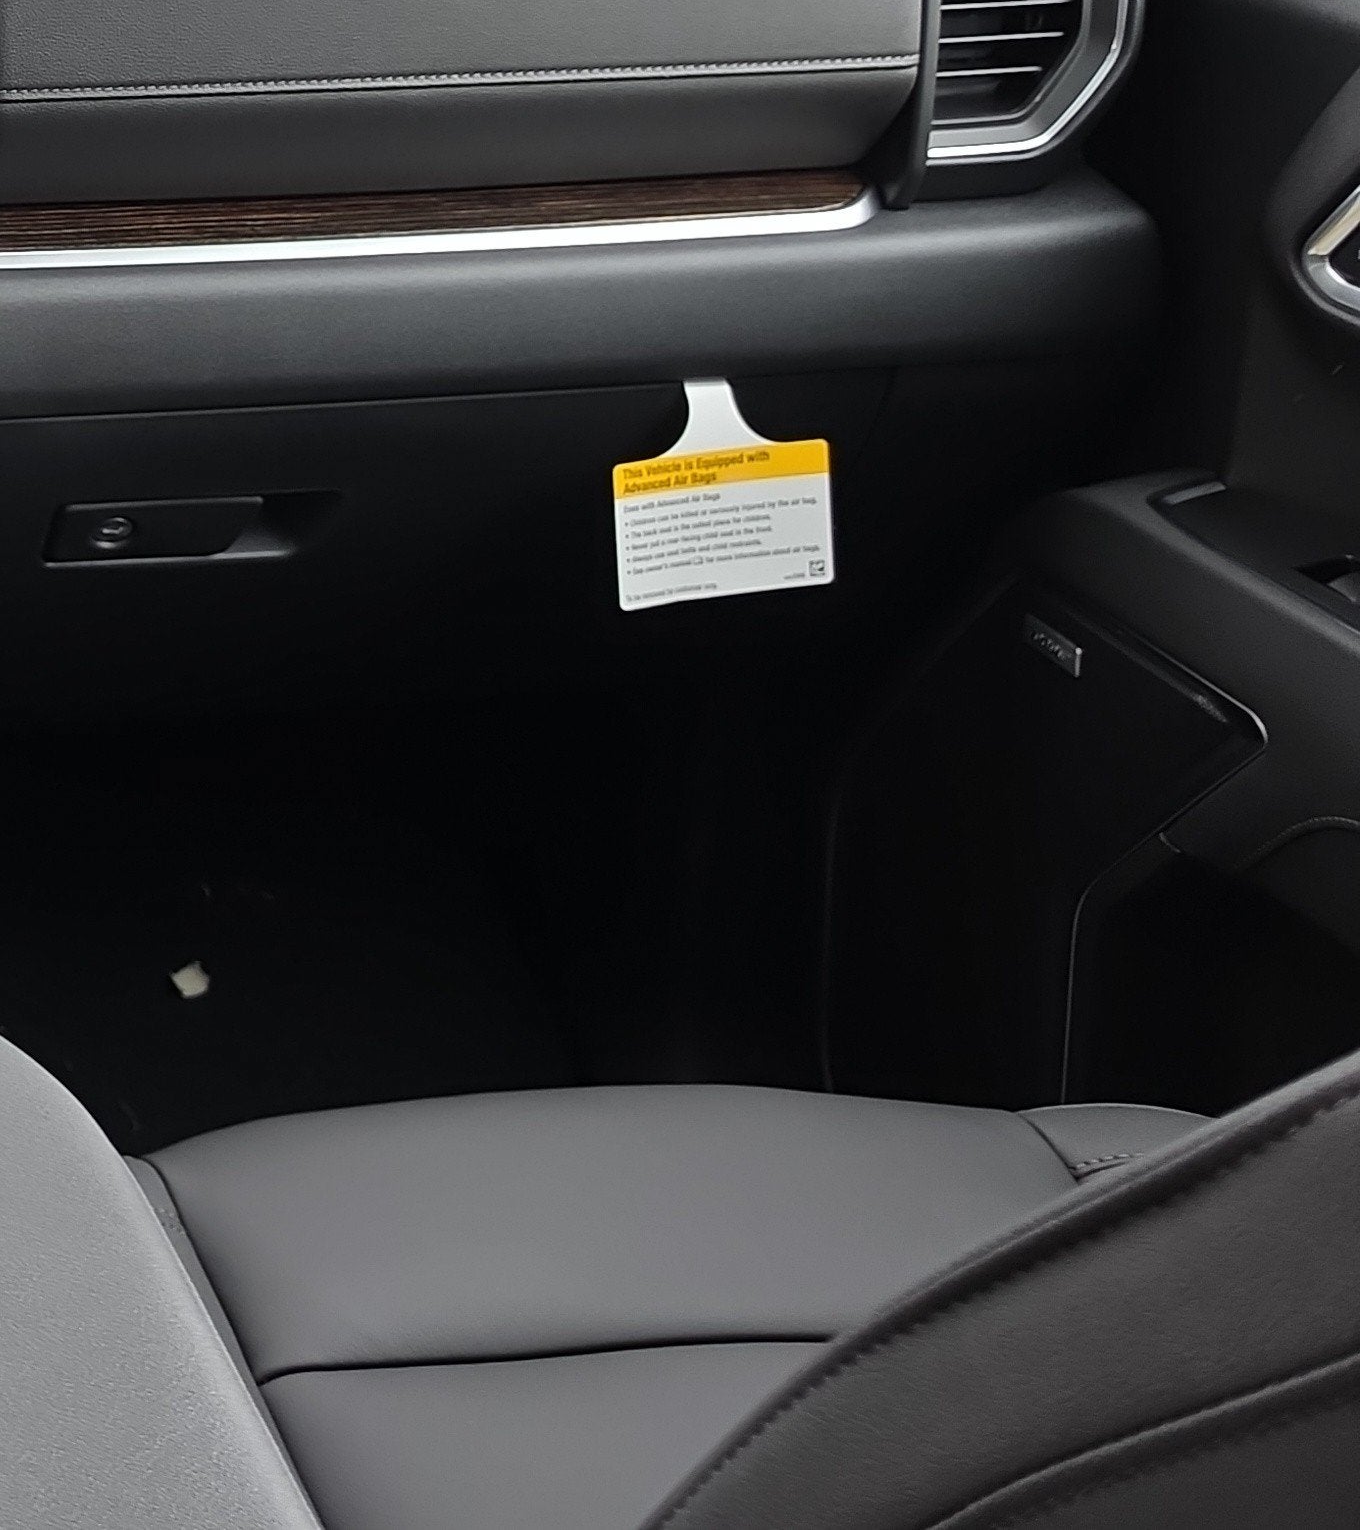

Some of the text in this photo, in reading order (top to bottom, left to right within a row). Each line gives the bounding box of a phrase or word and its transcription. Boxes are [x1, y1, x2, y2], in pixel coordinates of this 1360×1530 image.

[623, 450, 770, 480] This Vehicle is Equipped with
[623, 471, 716, 495] Advanced Air Bags
